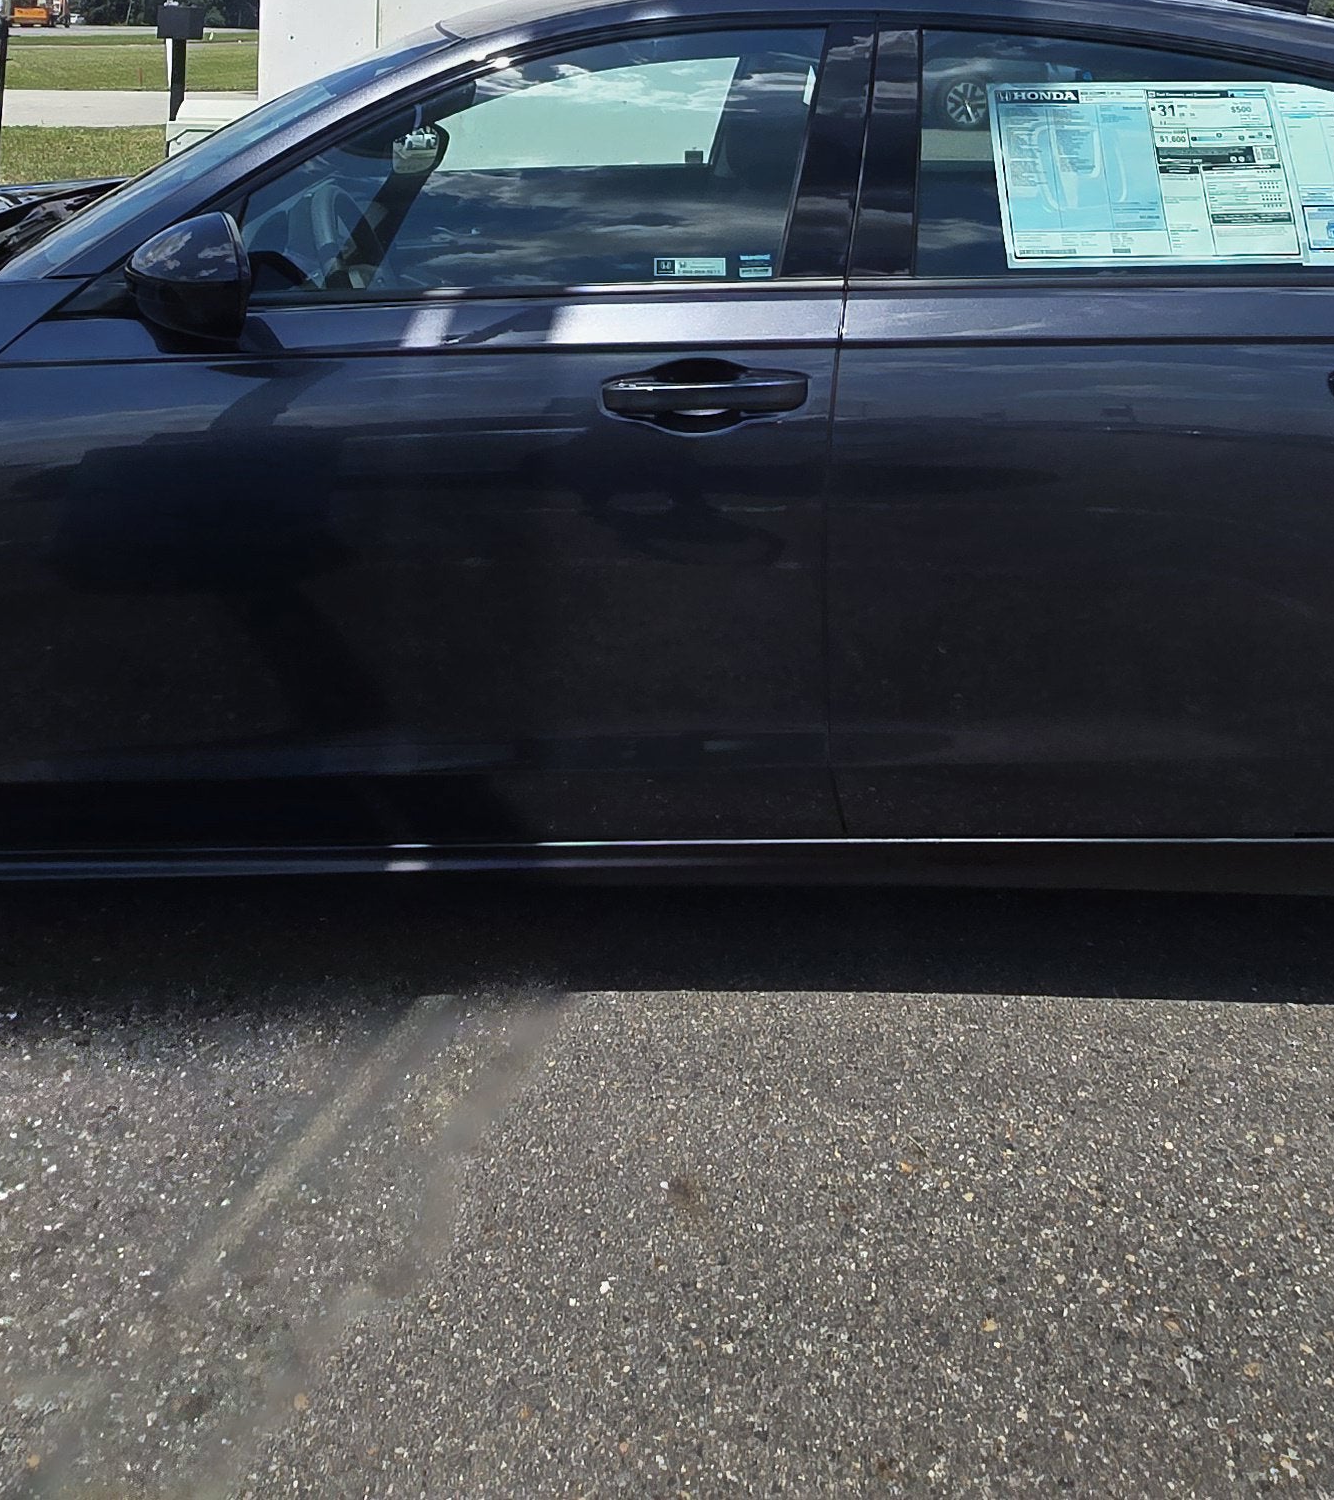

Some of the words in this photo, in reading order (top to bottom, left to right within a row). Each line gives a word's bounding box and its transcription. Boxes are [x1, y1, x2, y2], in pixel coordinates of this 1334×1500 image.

[1013, 91, 1078, 102] HONDA
[1157, 104, 1177, 117] 31
[1230, 105, 1252, 115] $500
[1159, 134, 1186, 144] $1,600
